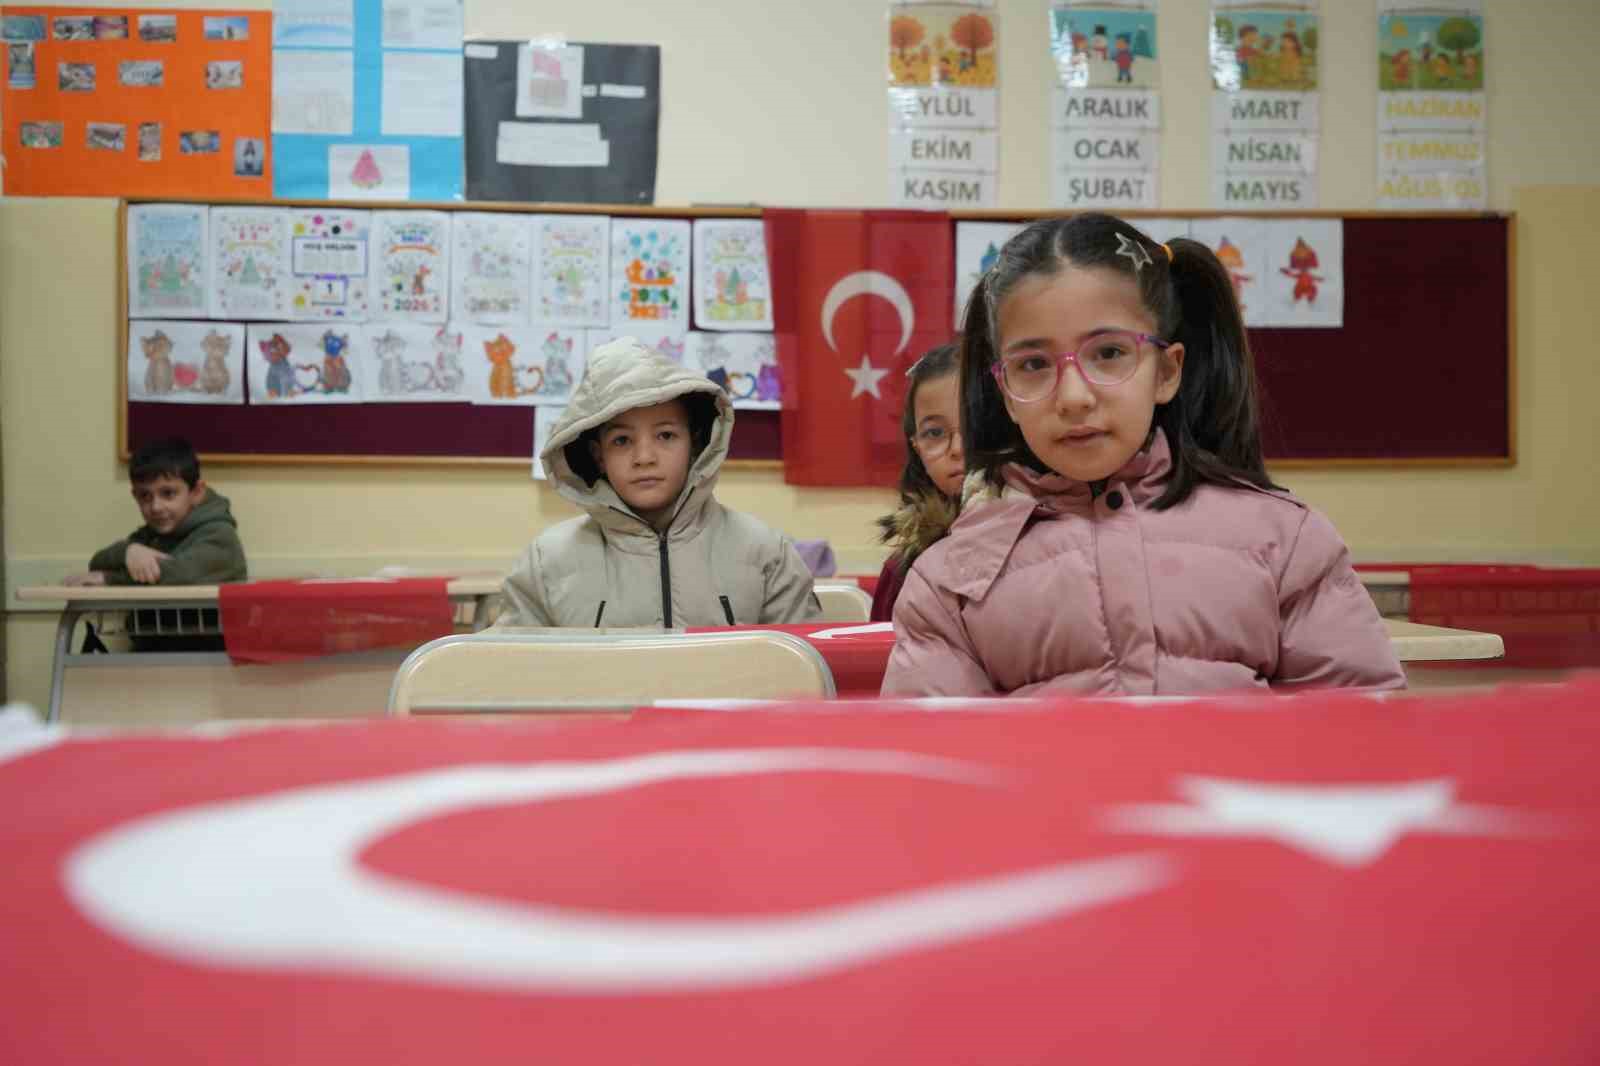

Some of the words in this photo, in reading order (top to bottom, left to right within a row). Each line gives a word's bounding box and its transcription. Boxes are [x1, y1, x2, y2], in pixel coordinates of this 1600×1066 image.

[1066, 98, 1149, 118] ARALIK
[1232, 100, 1301, 119] MART
[910, 136, 971, 160] EKİM
[1074, 140, 1140, 160] OCAK
[1229, 141, 1301, 162] NİSAN
[1383, 142, 1482, 161] TEMMUZ
[904, 179, 980, 201] KASIM
[1069, 180, 1144, 203] ŞUBAT
[1225, 182, 1300, 201] MAYIS
[1380, 178, 1480, 197] AĞUSOS
